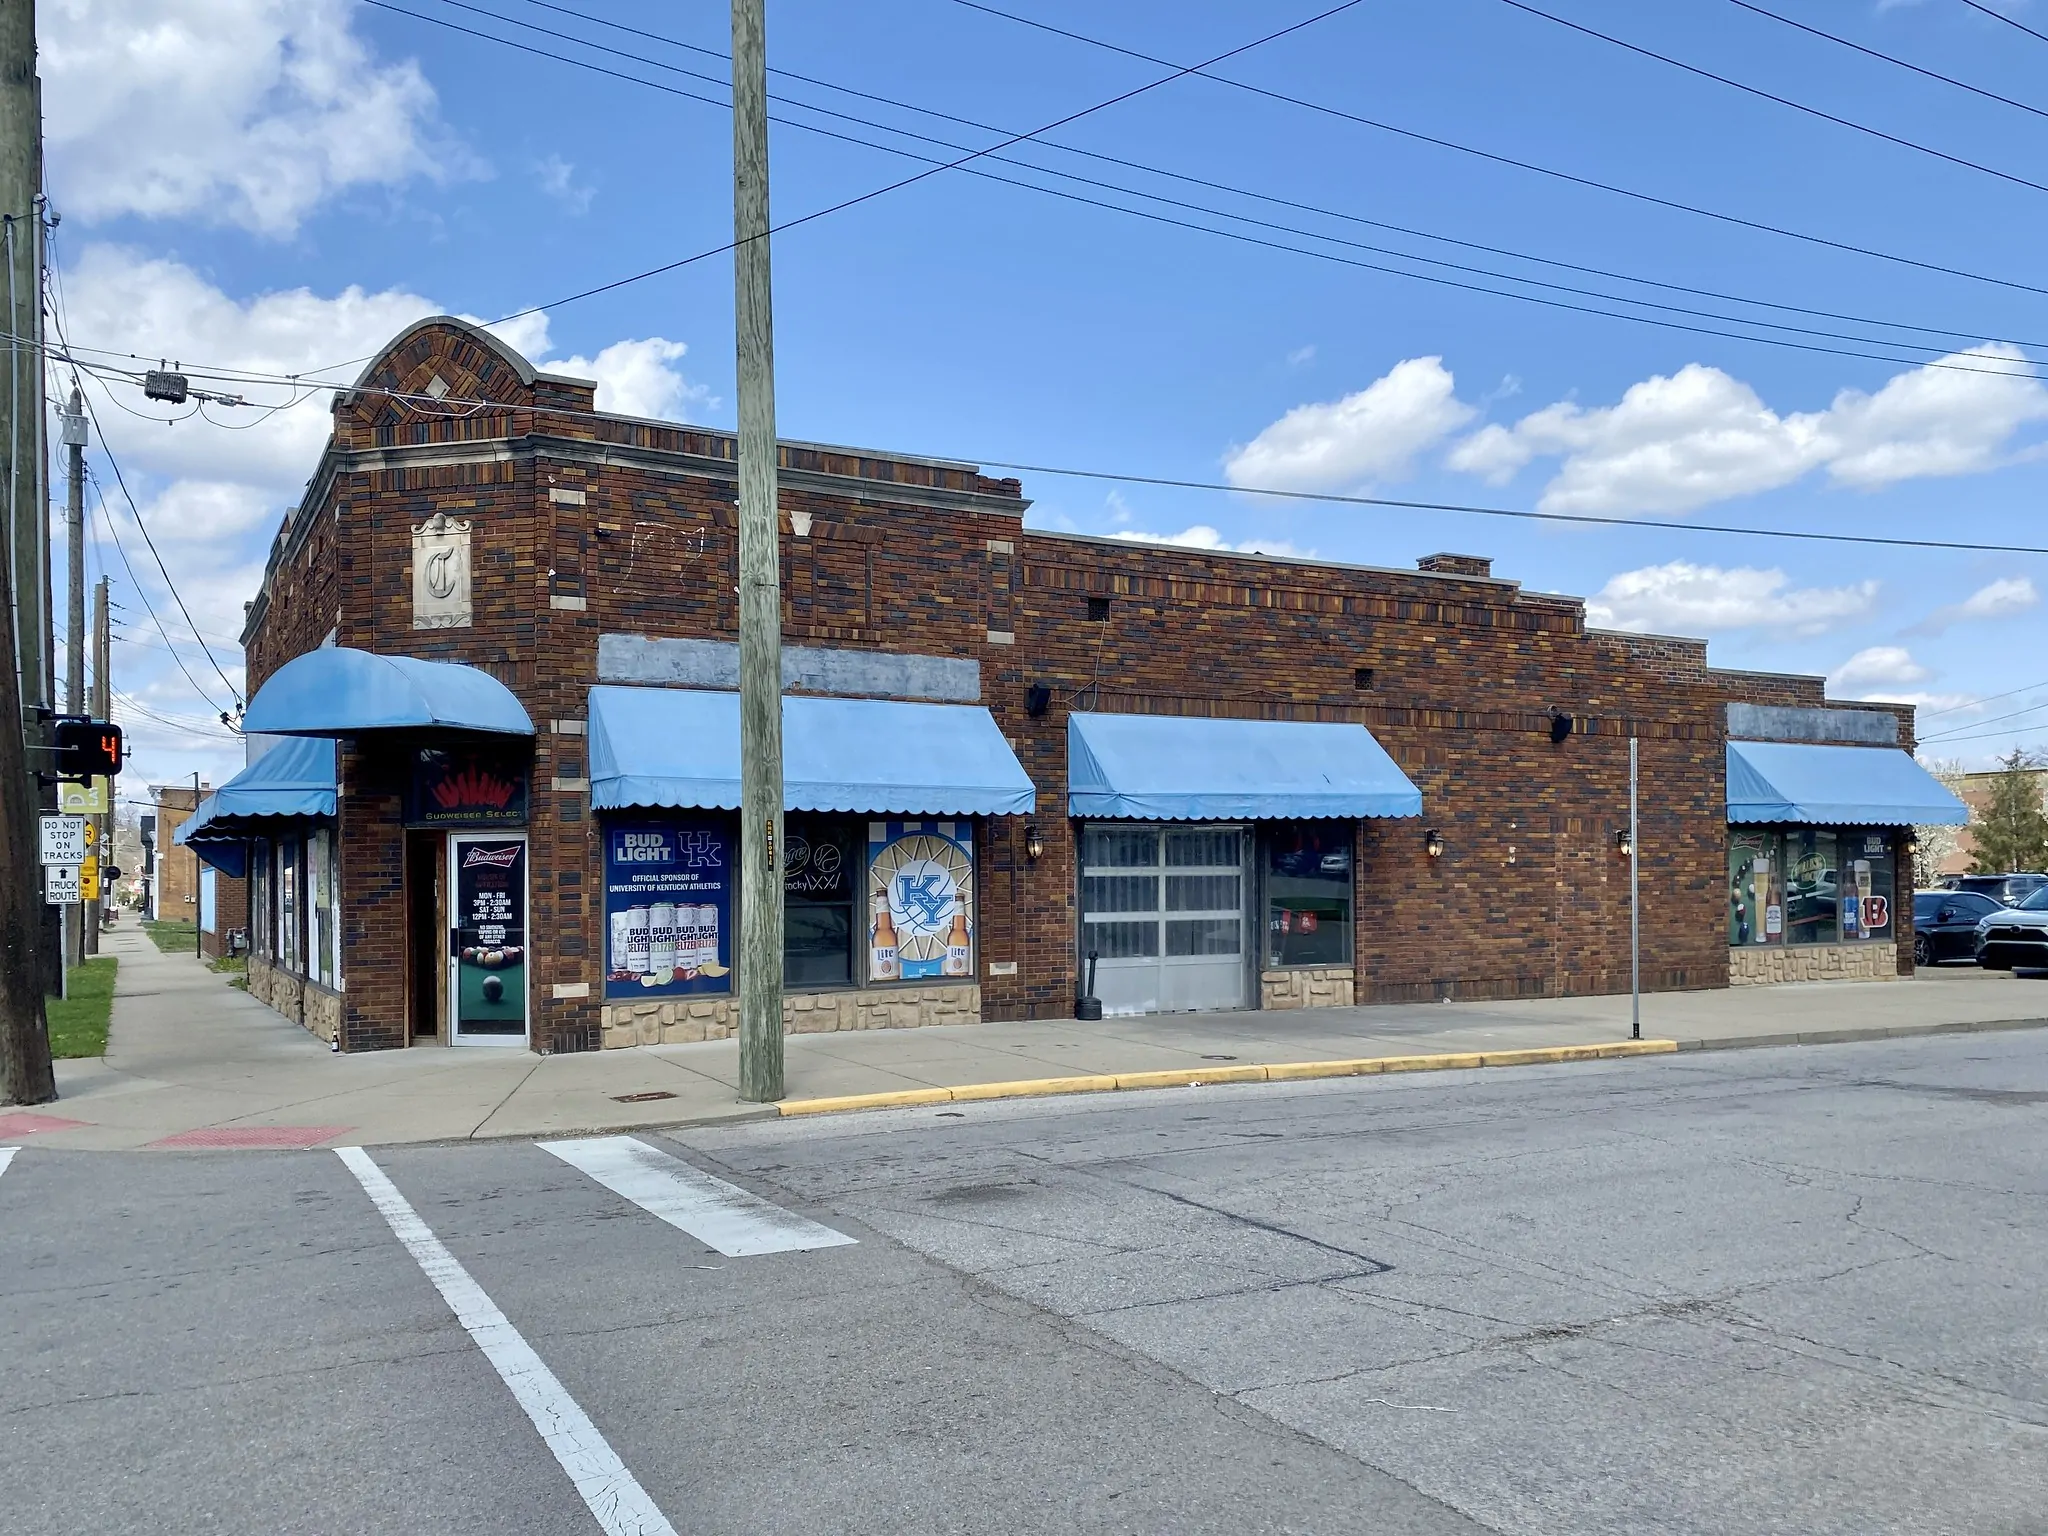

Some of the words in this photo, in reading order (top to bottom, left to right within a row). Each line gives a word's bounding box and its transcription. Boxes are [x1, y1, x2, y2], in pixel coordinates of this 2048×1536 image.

[101, 736, 116, 764] 4
[44, 821, 57, 829] DO
[63, 821, 81, 829] NOT
[50, 831, 76, 839] STOP
[55, 841, 71, 849] ON
[624, 833, 664, 848] BUD
[1866, 836, 1881, 845] BUD
[678, 831, 722, 867] UK
[1864, 844, 1885, 853] LIGHT
[43, 851, 83, 860] TRACKS
[467, 851, 515, 862] Budweiser
[617, 847, 671, 861] LIGHT
[632, 874, 660, 882] OFFICIAL
[660, 874, 690, 882] SPONSOR
[49, 881, 77, 890] TRUCK
[609, 884, 647, 893] UNIVERSITY
[656, 883, 689, 891] KENTUCKY
[689, 882, 721, 890] ATHLETICS
[49, 891, 78, 900] ROUTE
[899, 875, 953, 925] KY
[1860, 896, 1888, 928] B
[650, 935, 676, 943] LIGHT
[877, 949, 894, 960] Lite
[951, 948, 966, 957] Lite
